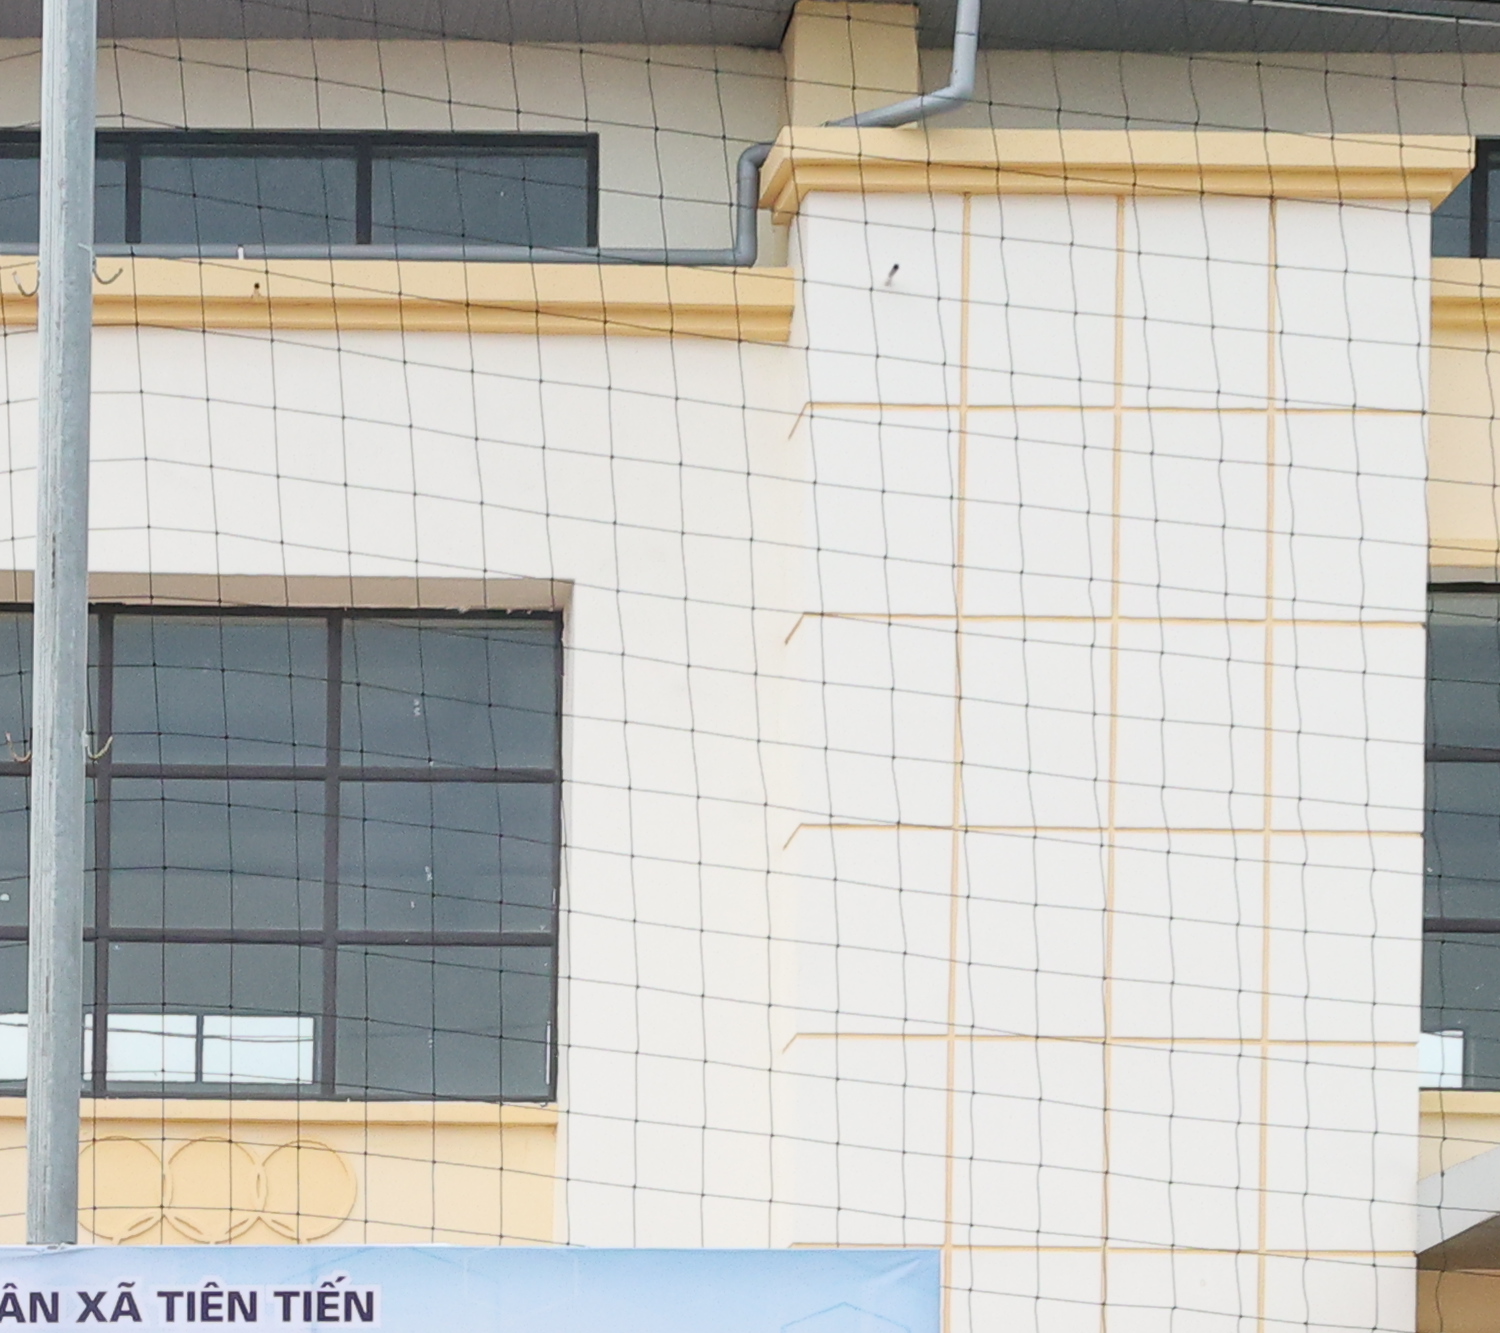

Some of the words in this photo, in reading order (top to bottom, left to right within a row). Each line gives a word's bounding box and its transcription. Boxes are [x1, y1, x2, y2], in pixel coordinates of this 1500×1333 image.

[76, 1281, 142, 1323] XÃ
[157, 1282, 257, 1323] TIÊN
[273, 1276, 376, 1323] TIẾN
